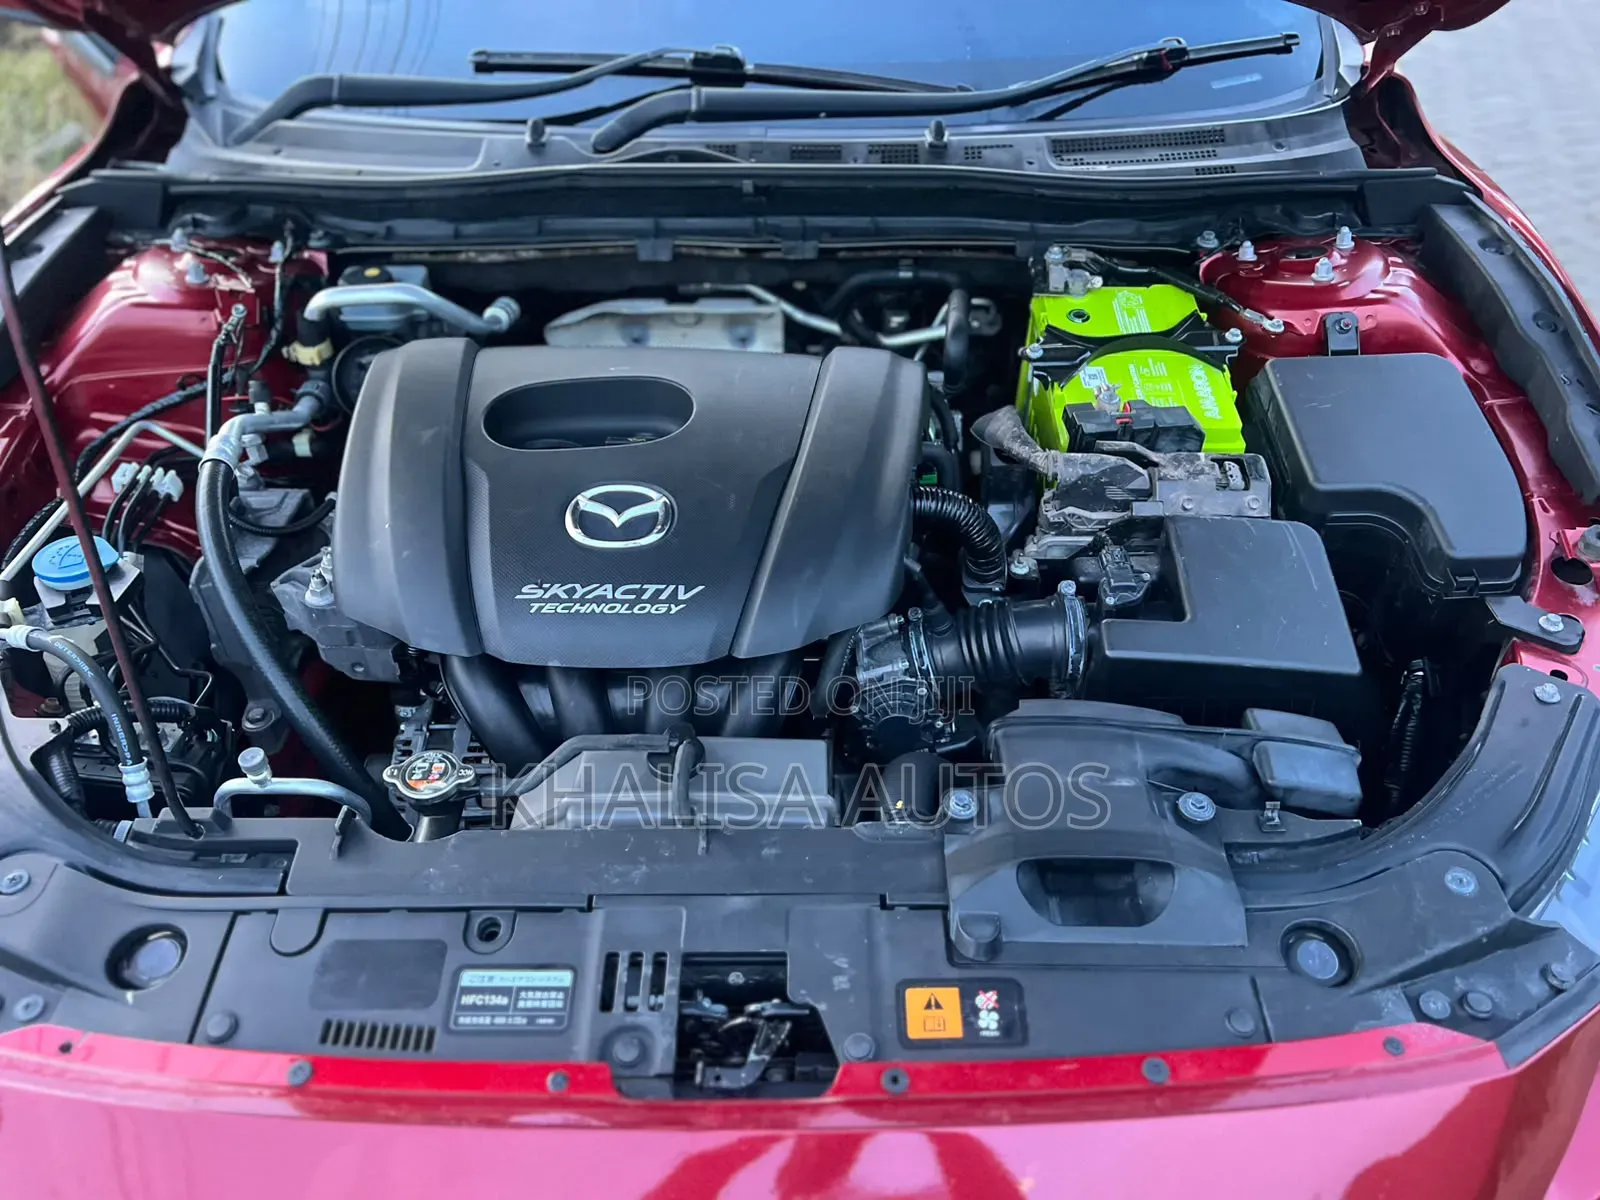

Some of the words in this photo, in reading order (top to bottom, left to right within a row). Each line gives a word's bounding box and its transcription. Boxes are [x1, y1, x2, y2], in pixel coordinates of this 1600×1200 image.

[1188, 363, 1222, 419] AMARON
[514, 583, 706, 601] SKYACTIV
[529, 603, 687, 615] TECHNOLOGY
[460, 994, 510, 1006] HFC134a
